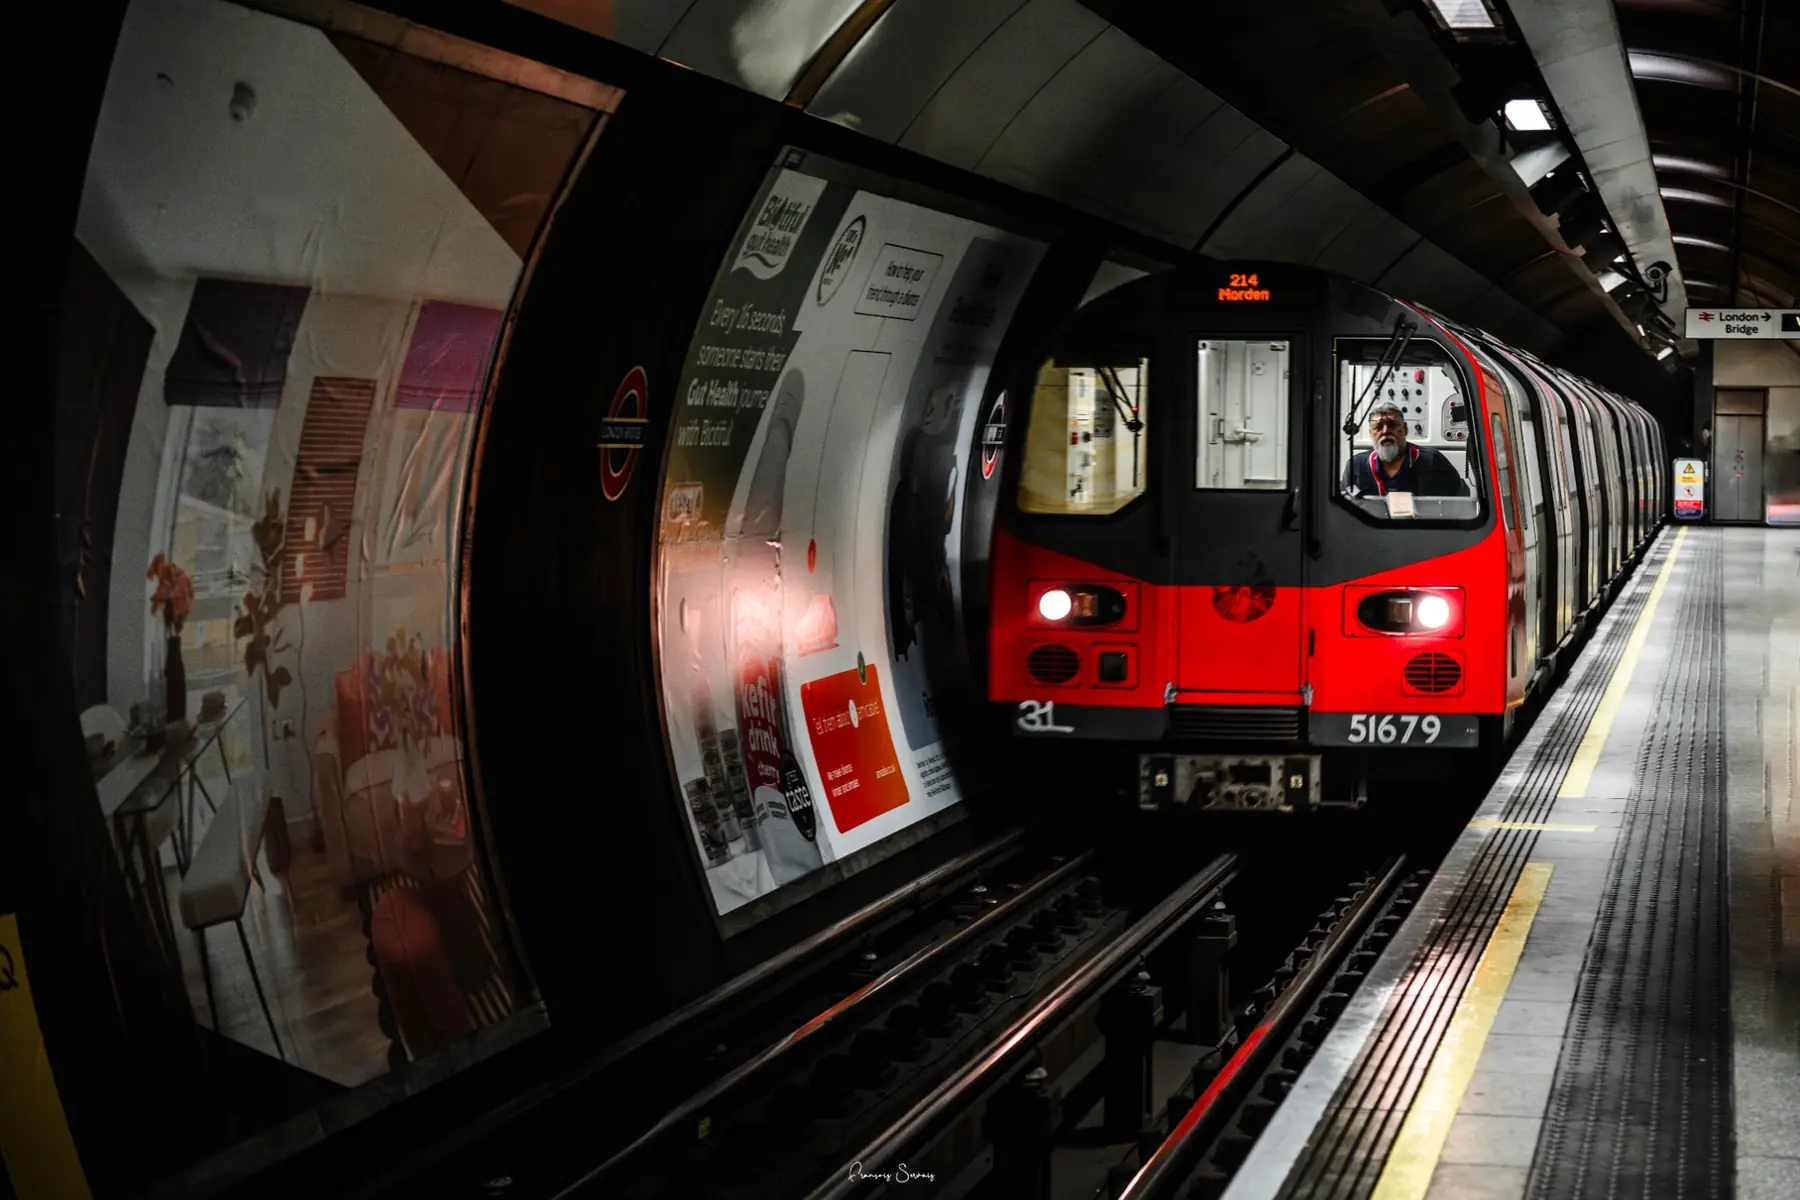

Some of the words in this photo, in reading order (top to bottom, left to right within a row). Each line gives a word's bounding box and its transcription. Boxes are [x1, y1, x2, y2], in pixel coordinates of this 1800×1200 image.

[743, 232, 767, 256] gut
[762, 234, 793, 258] health
[1229, 272, 1260, 287] 214
[1217, 287, 1271, 301] Morden
[710, 298, 738, 334] Every
[736, 302, 754, 330] 16
[1719, 312, 1759, 322] London
[1725, 324, 1759, 335] Bridge
[696, 345, 741, 368] someone
[740, 346, 767, 370] starts
[687, 377, 708, 406] Gut
[706, 379, 739, 407] Health
[679, 418, 700, 446] with
[743, 676, 777, 727] kefir
[1017, 700, 1074, 733] 31
[1347, 713, 1442, 744] 51679
[748, 719, 781, 759] drink
[785, 785, 812, 813] taste
